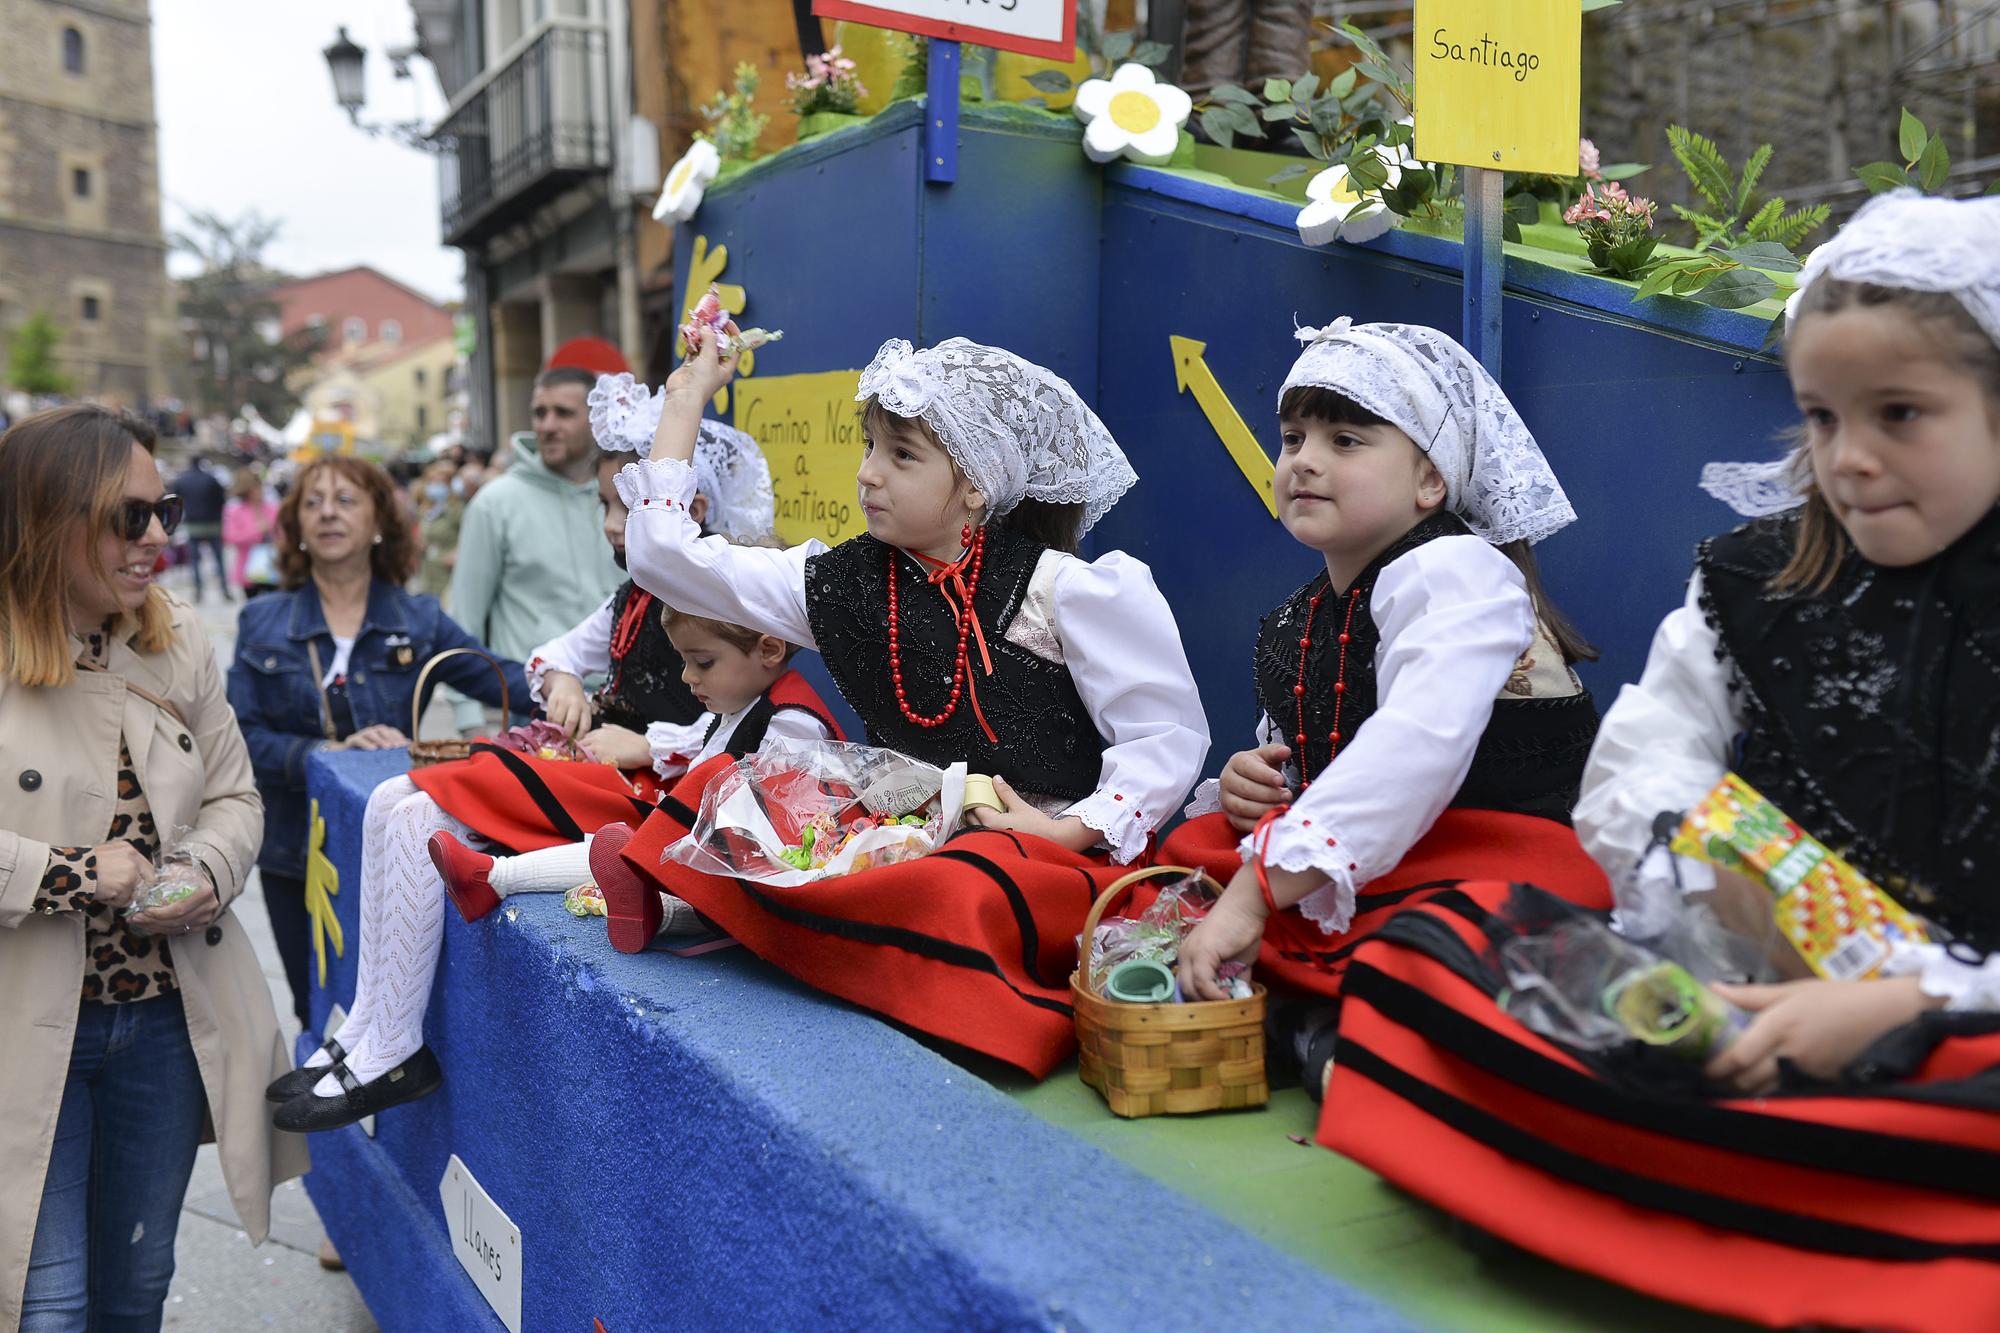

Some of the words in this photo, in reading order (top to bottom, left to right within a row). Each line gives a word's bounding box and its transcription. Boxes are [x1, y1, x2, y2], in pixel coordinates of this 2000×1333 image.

[1430, 28, 1539, 81] Santiago
[745, 398, 811, 444] Camino
[825, 400, 864, 444] Nort
[795, 454, 809, 476] a
[773, 478, 849, 538] Santiago
